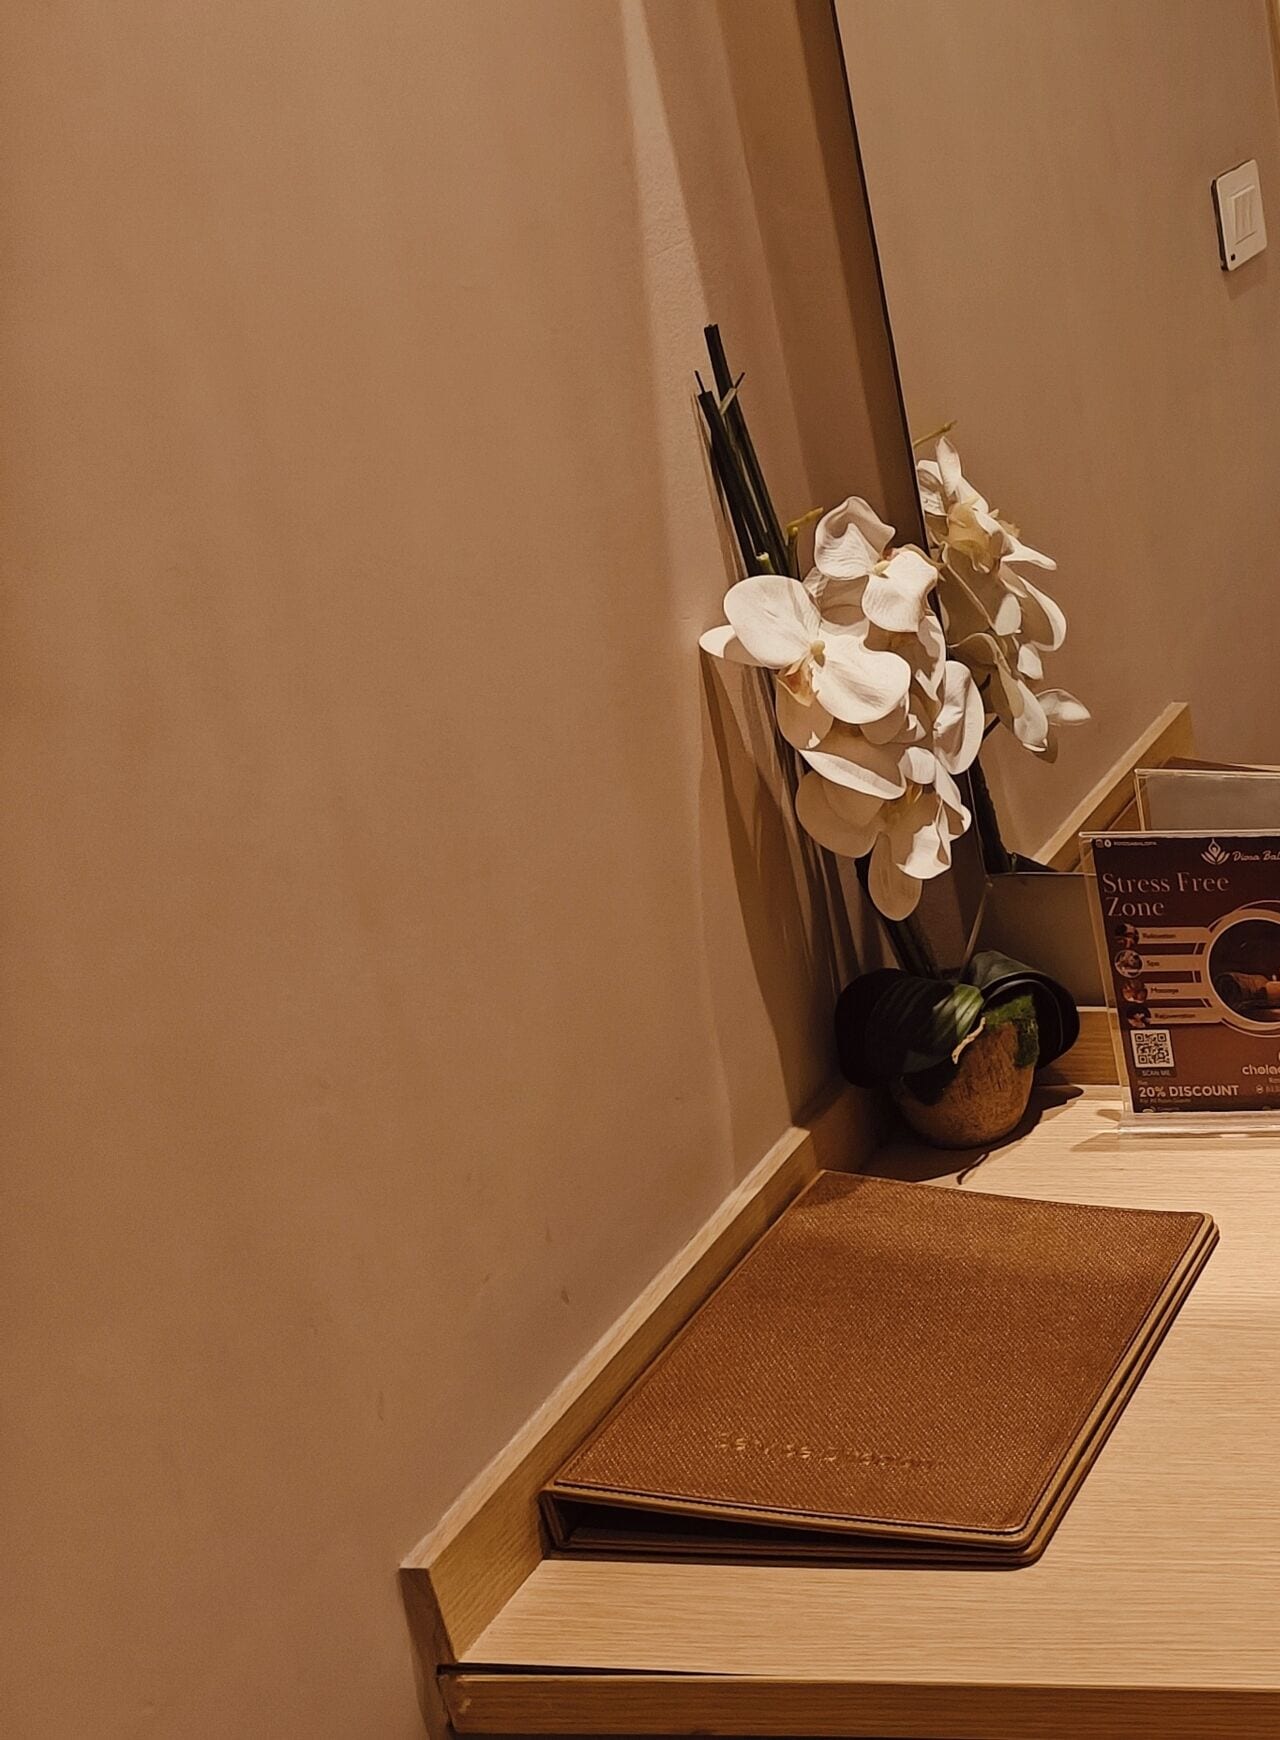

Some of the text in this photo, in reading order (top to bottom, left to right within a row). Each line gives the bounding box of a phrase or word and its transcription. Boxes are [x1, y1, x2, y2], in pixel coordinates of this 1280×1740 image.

[1102, 872, 1229, 893] Stress Free
[1105, 897, 1165, 917] Zone
[1138, 1085, 1239, 1098] 20% DISCOUNT
